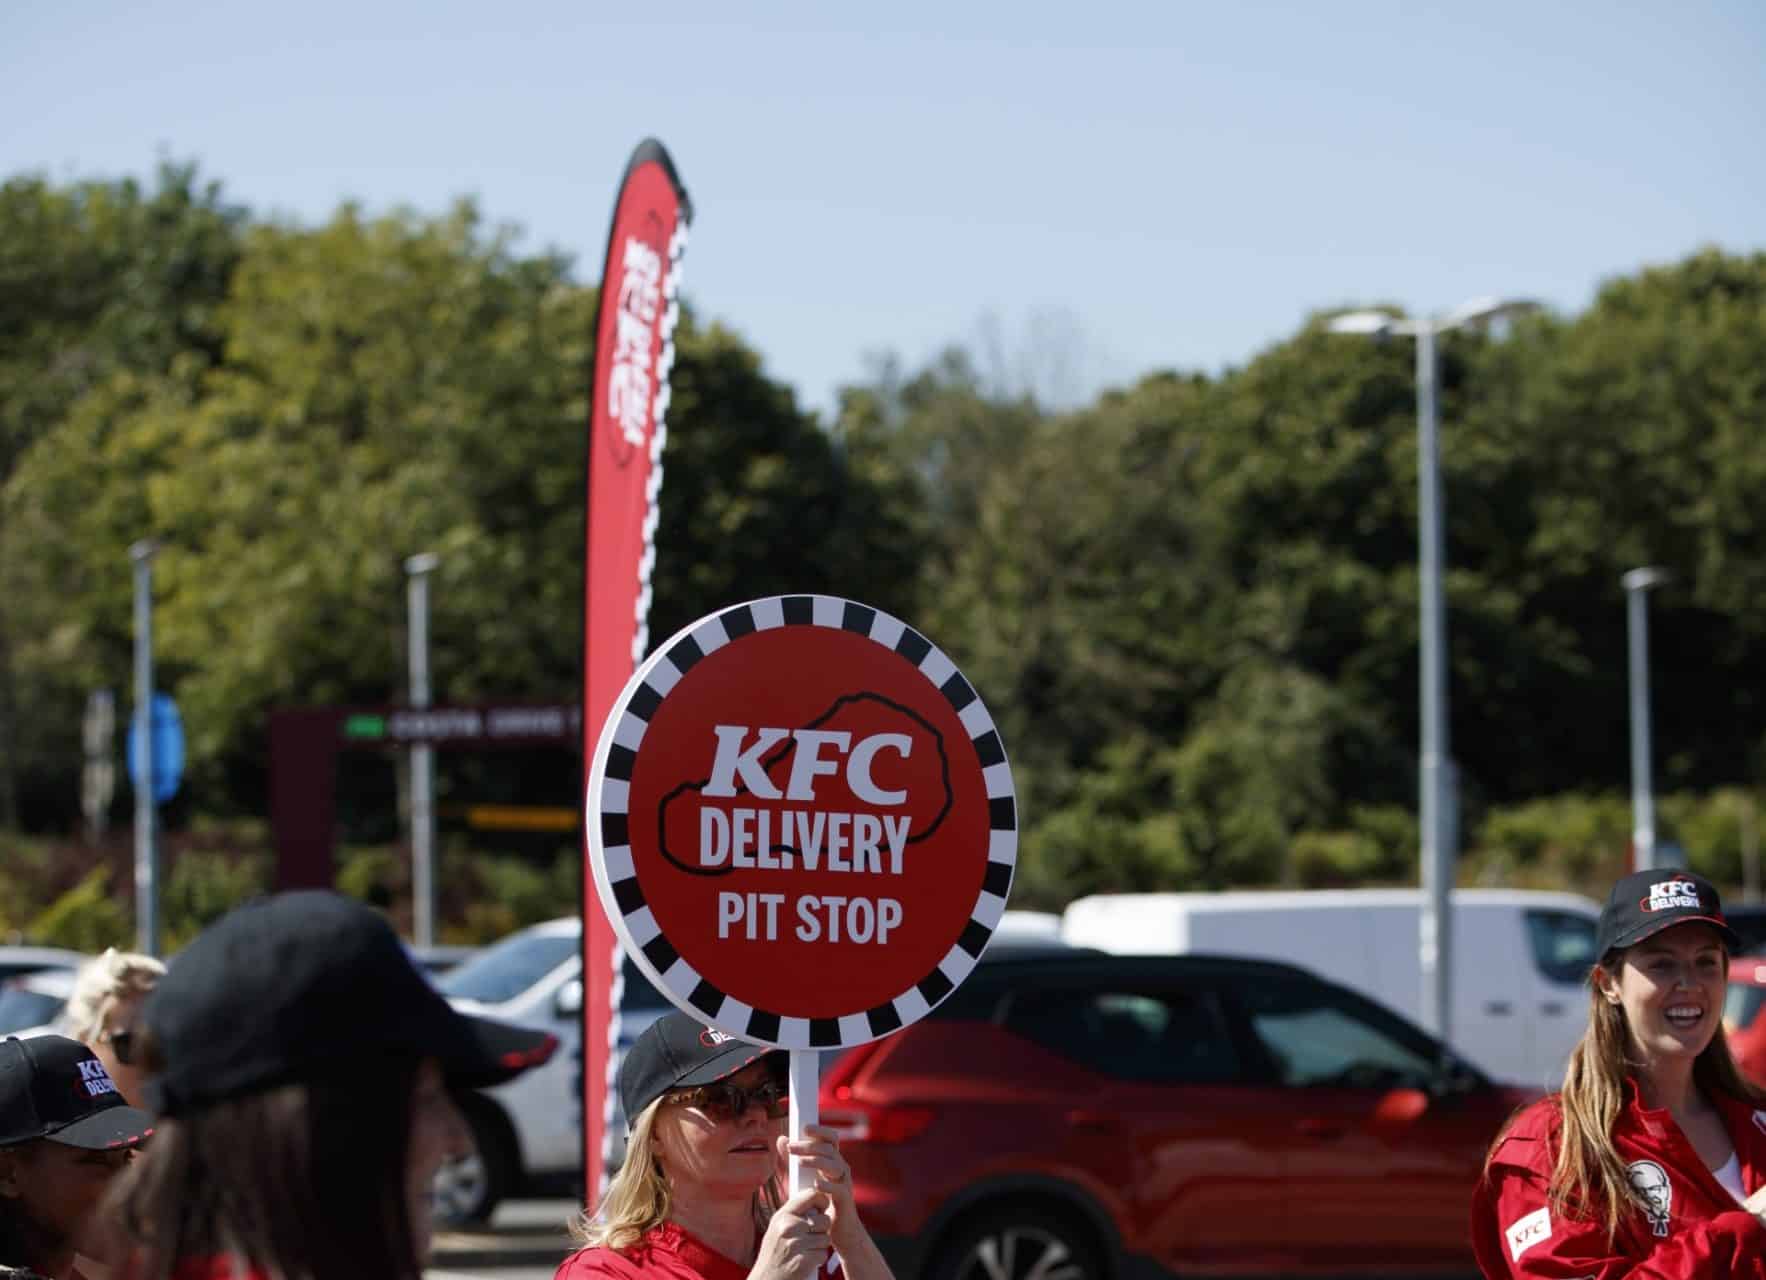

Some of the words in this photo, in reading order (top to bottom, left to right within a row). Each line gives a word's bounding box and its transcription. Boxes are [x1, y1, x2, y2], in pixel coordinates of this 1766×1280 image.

[700, 725, 912, 806] KFC
[699, 806, 912, 874] DELIVERY
[718, 891, 785, 940] PIT
[795, 894, 903, 944] STOP
[1650, 880, 1697, 897] KFC
